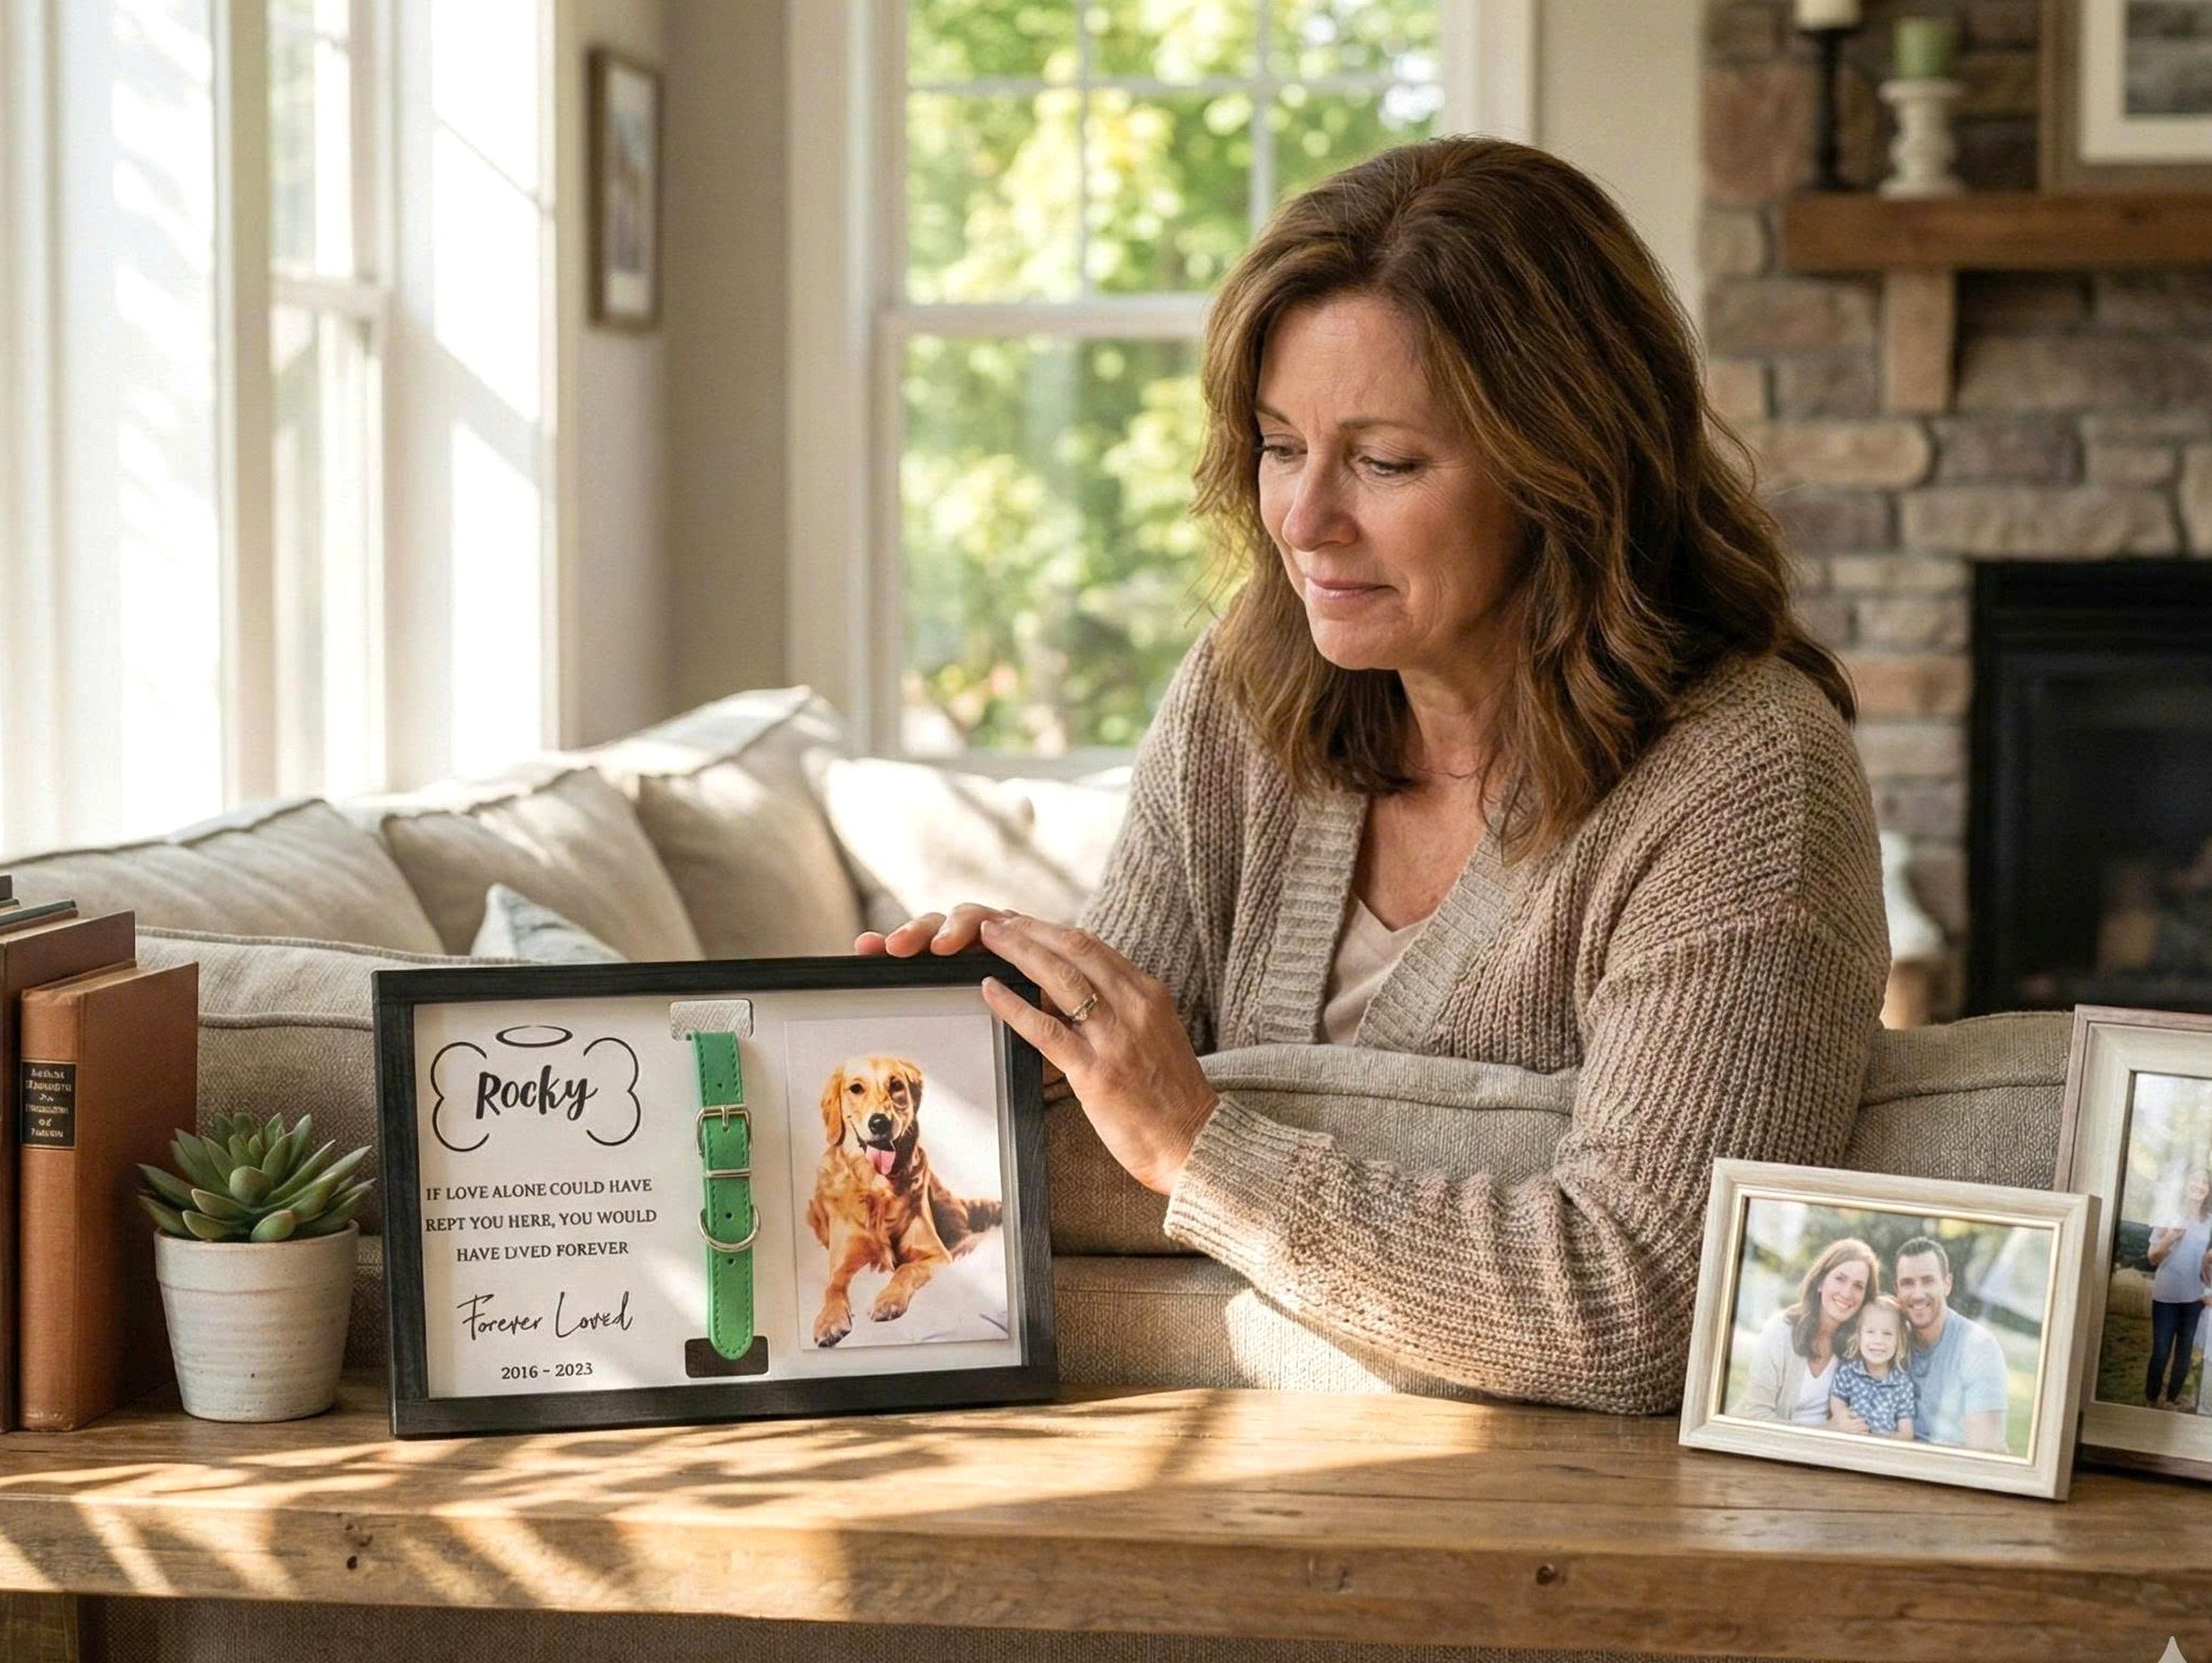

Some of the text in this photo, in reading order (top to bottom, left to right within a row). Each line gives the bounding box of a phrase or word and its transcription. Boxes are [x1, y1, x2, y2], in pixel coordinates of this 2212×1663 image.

[476, 1064, 599, 1121] Rocky
[426, 1178, 652, 1201] IF LOVE ALONE COULD HAVE
[469, 1215, 503, 1230] YOU
[558, 1211, 593, 1226] YOU
[596, 1209, 658, 1225] WOULD
[457, 1246, 500, 1262] HAVE
[556, 1241, 629, 1257] FOREVER
[456, 1290, 634, 1341] Forever Loved
[500, 1365, 538, 1380] 2016
[555, 1361, 593, 1377] 2023
